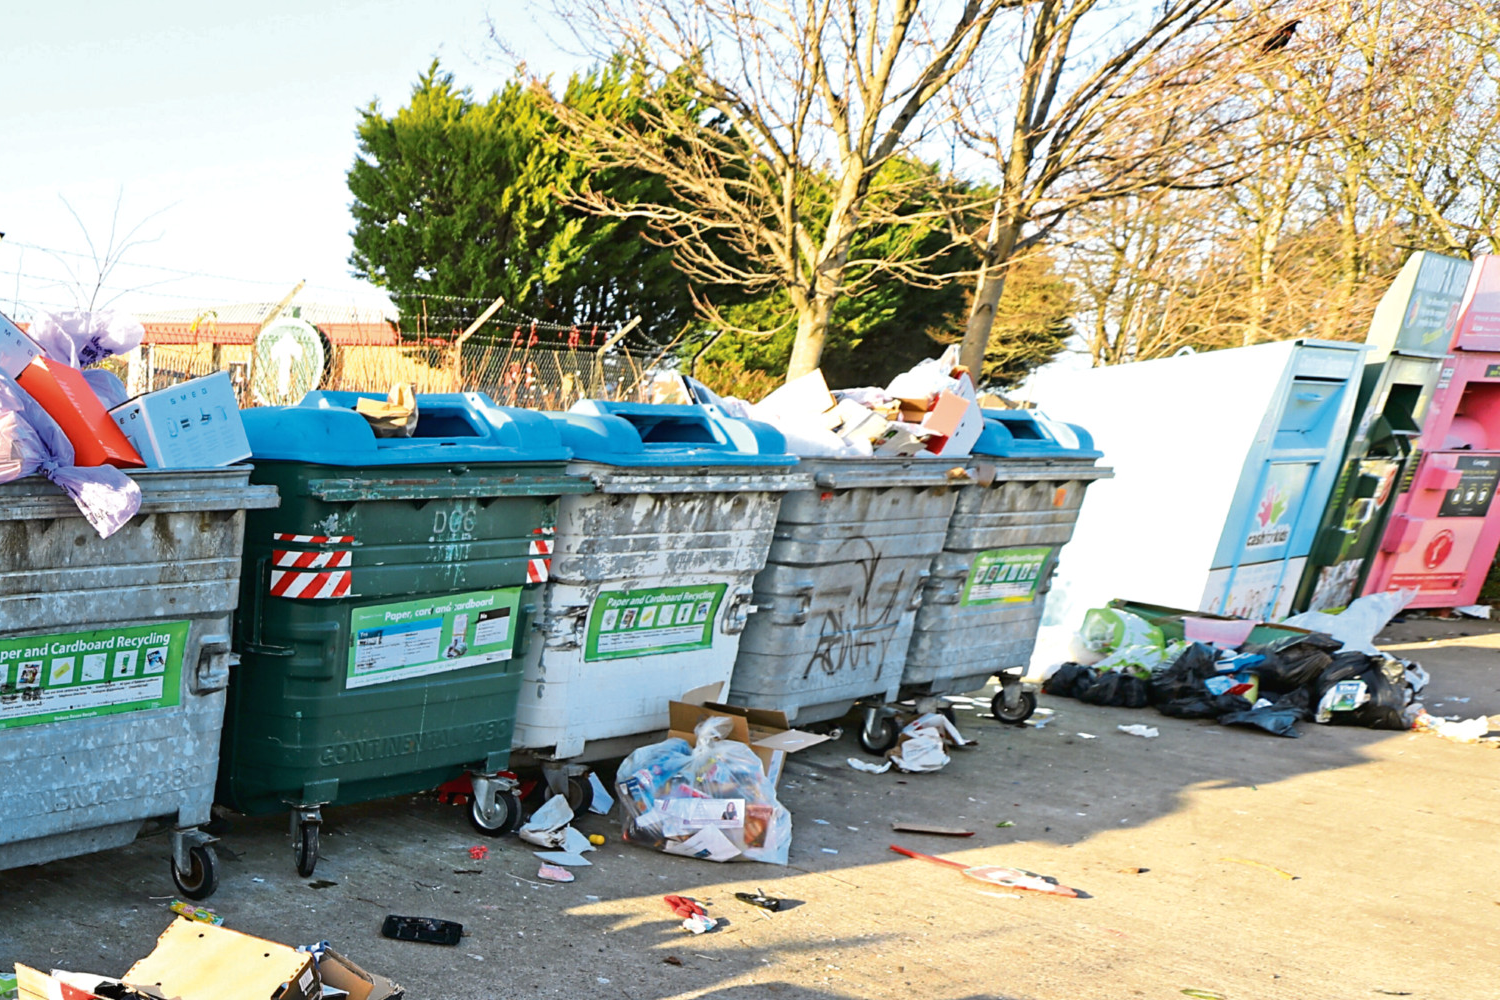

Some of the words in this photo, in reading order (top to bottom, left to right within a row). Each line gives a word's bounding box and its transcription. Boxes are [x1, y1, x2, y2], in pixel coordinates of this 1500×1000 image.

[171, 388, 208, 405] SMEG
[607, 597, 629, 607] Paper
[645, 593, 683, 604] Cardboard
[684, 590, 716, 602] Recycling
[384, 610, 413, 622] Paper,
[24, 643, 49, 657] and
[51, 636, 115, 655] Cardboard
[116, 633, 171, 649] Recycling
